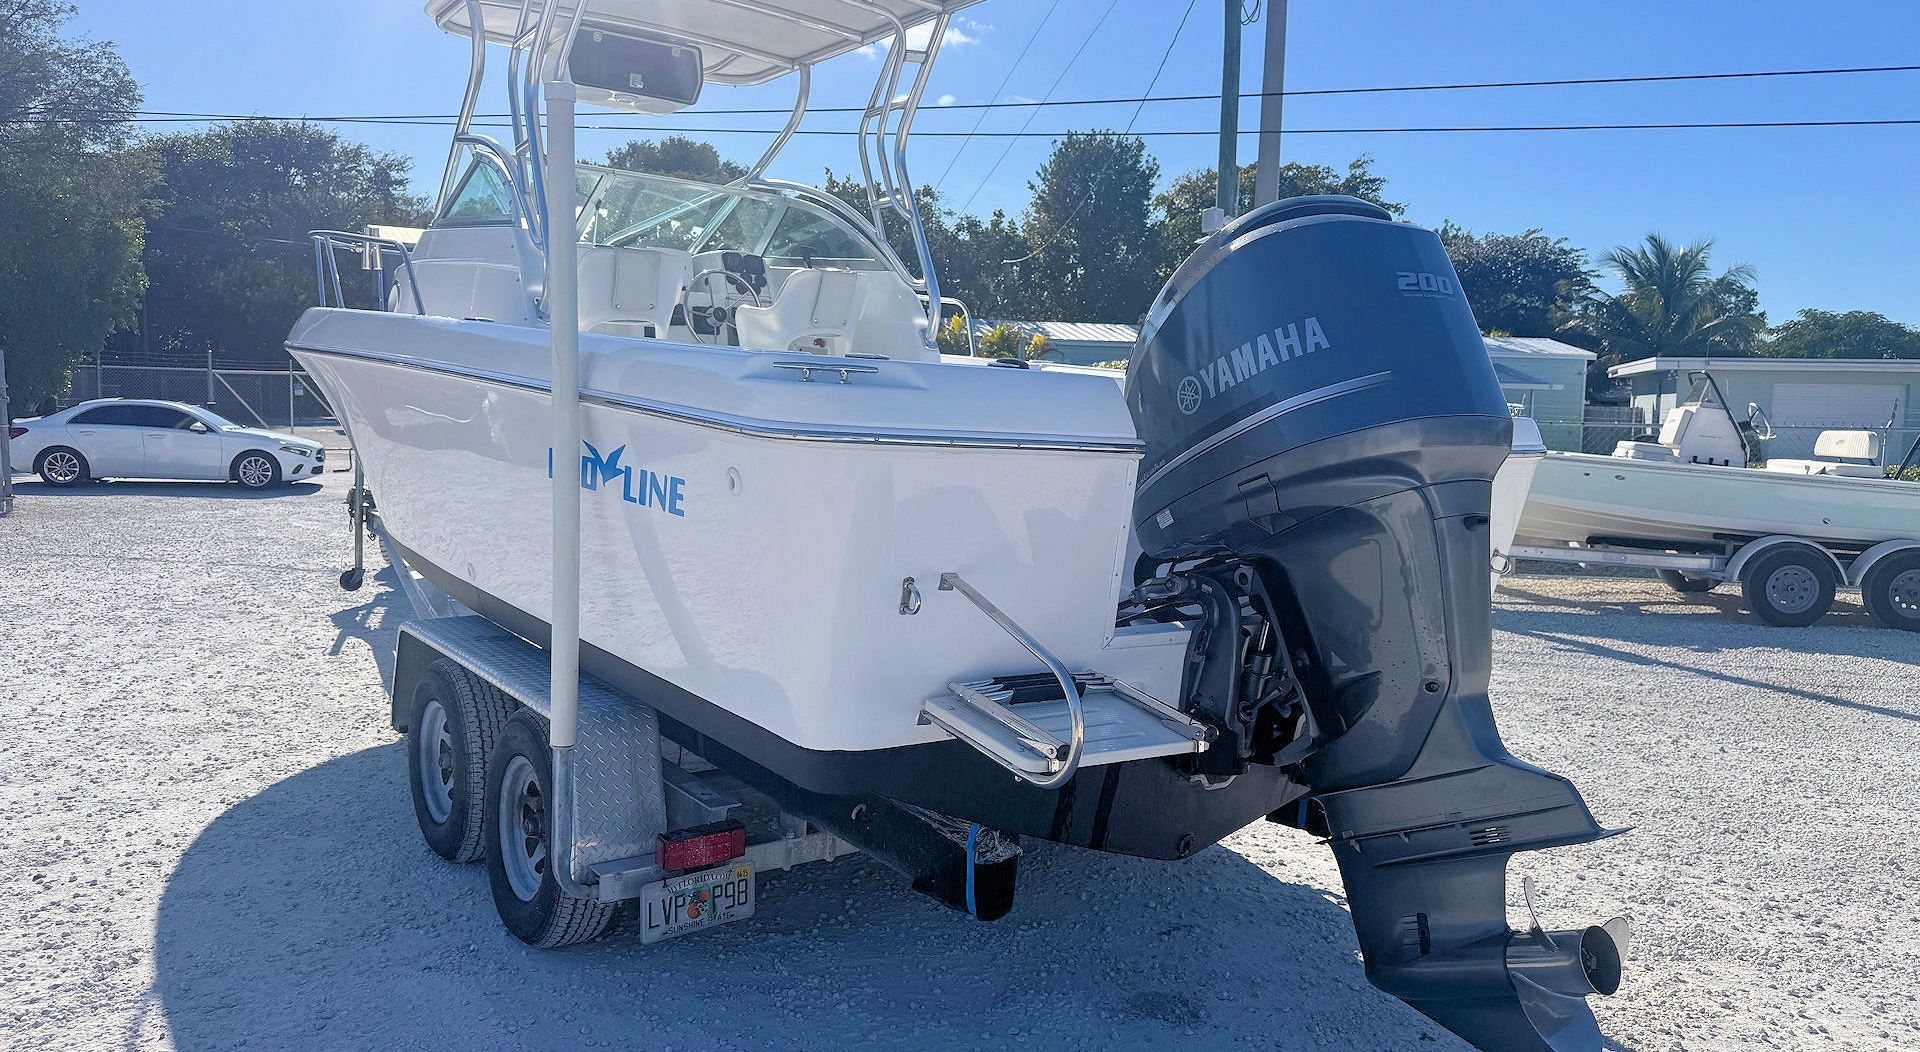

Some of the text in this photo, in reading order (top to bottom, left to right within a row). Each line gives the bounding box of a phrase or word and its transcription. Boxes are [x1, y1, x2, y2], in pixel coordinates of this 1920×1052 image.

[1396, 271, 1454, 295] 200
[1199, 316, 1330, 399] YAMAHA
[623, 465, 685, 518] LINE
[648, 895, 686, 929] LVP
[668, 919, 705, 935] SUNSHINE
